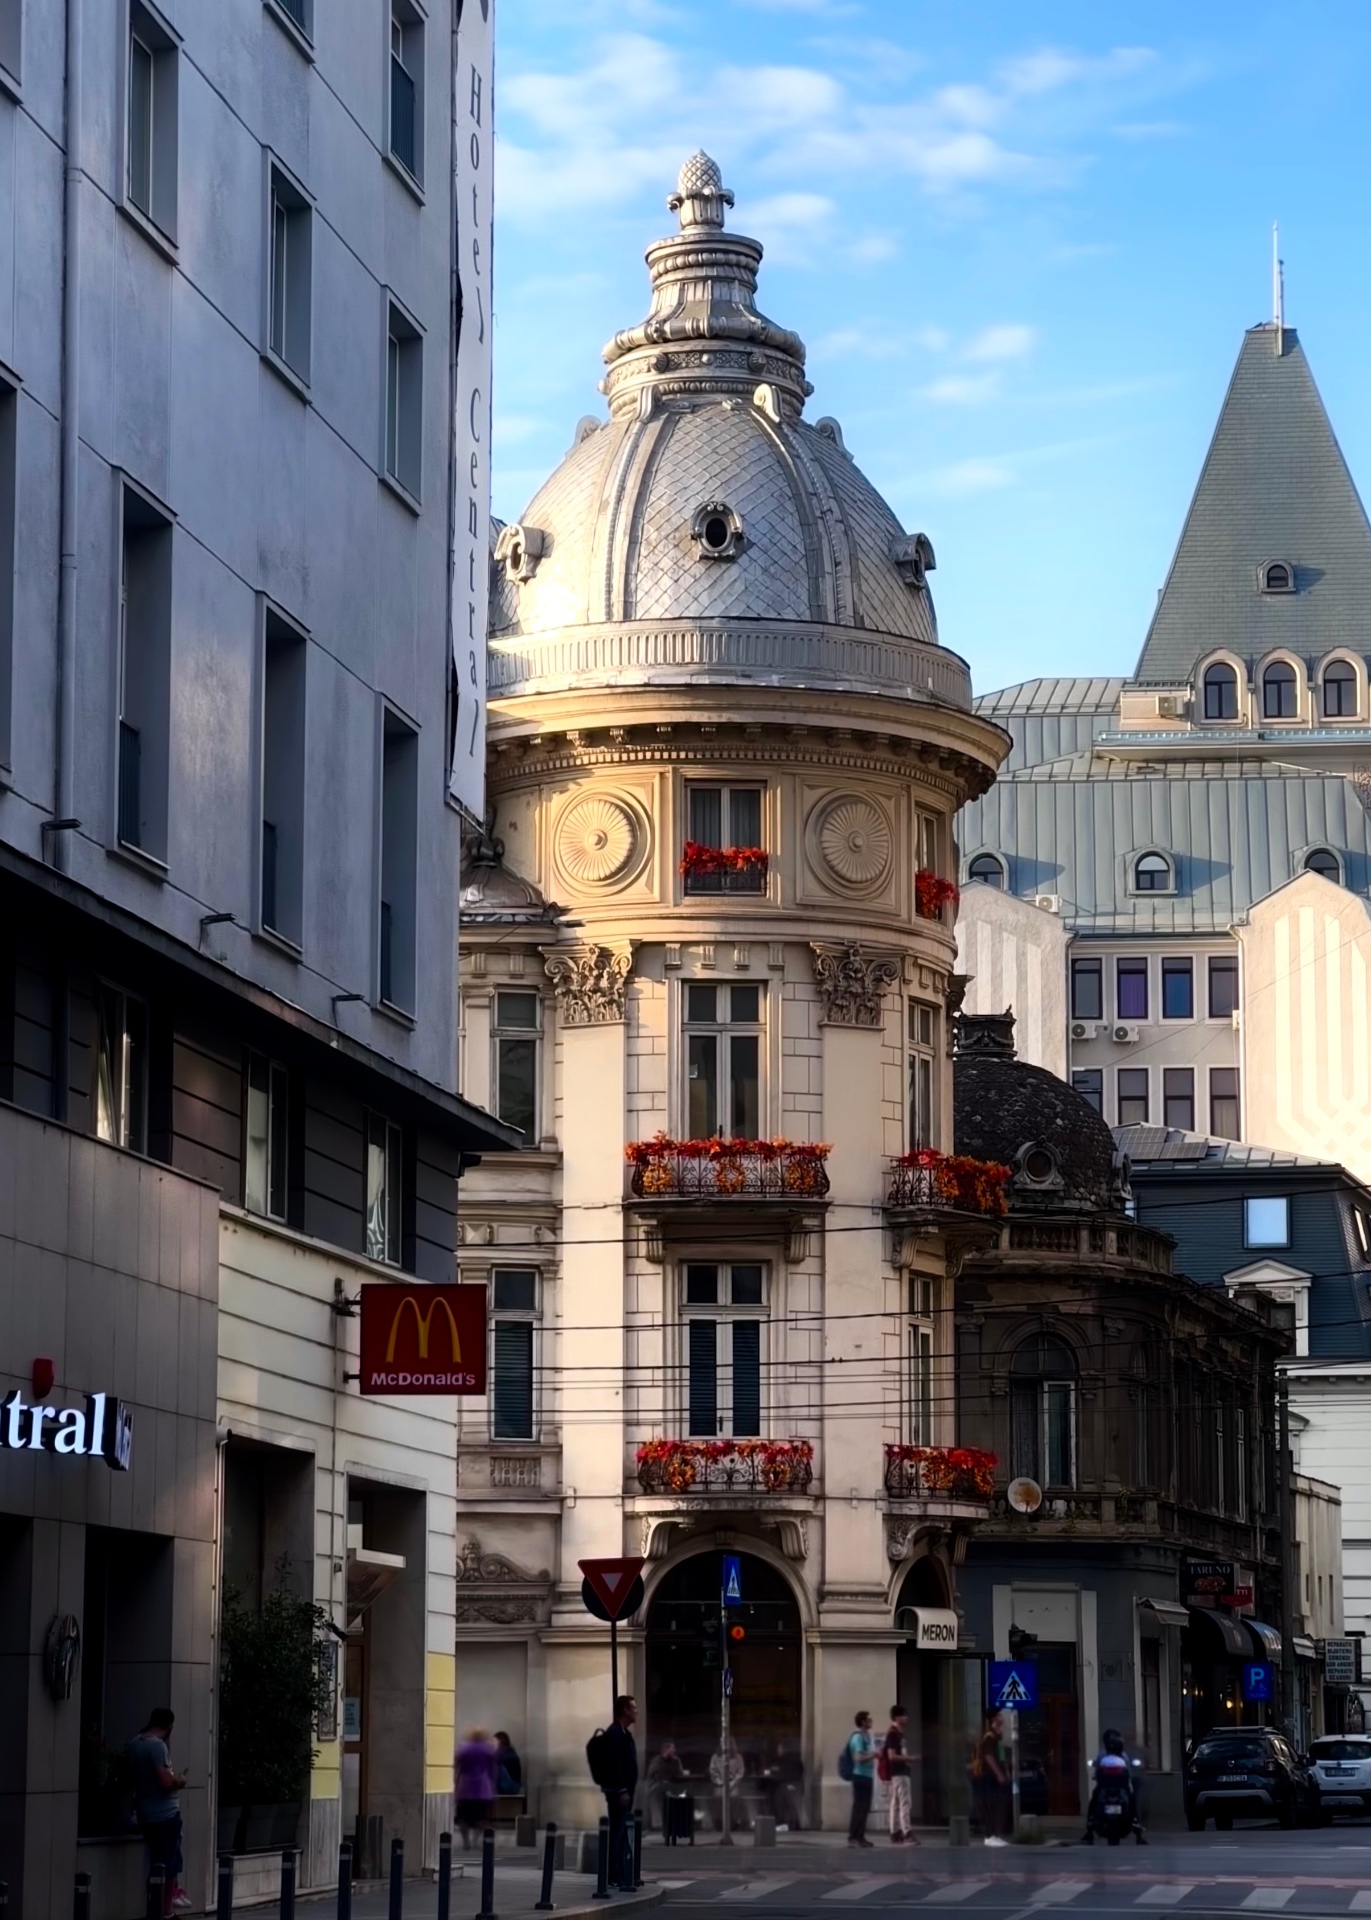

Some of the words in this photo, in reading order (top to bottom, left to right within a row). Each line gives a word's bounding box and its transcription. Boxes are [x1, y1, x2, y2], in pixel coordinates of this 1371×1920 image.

[469, 63, 484, 345] Hotel
[468, 387, 481, 757] Central
[370, 1371, 476, 1386] McDonald's
[0, 1389, 106, 1456] tral
[921, 1623, 955, 1642] MERON
[1250, 1667, 1265, 1686] P
